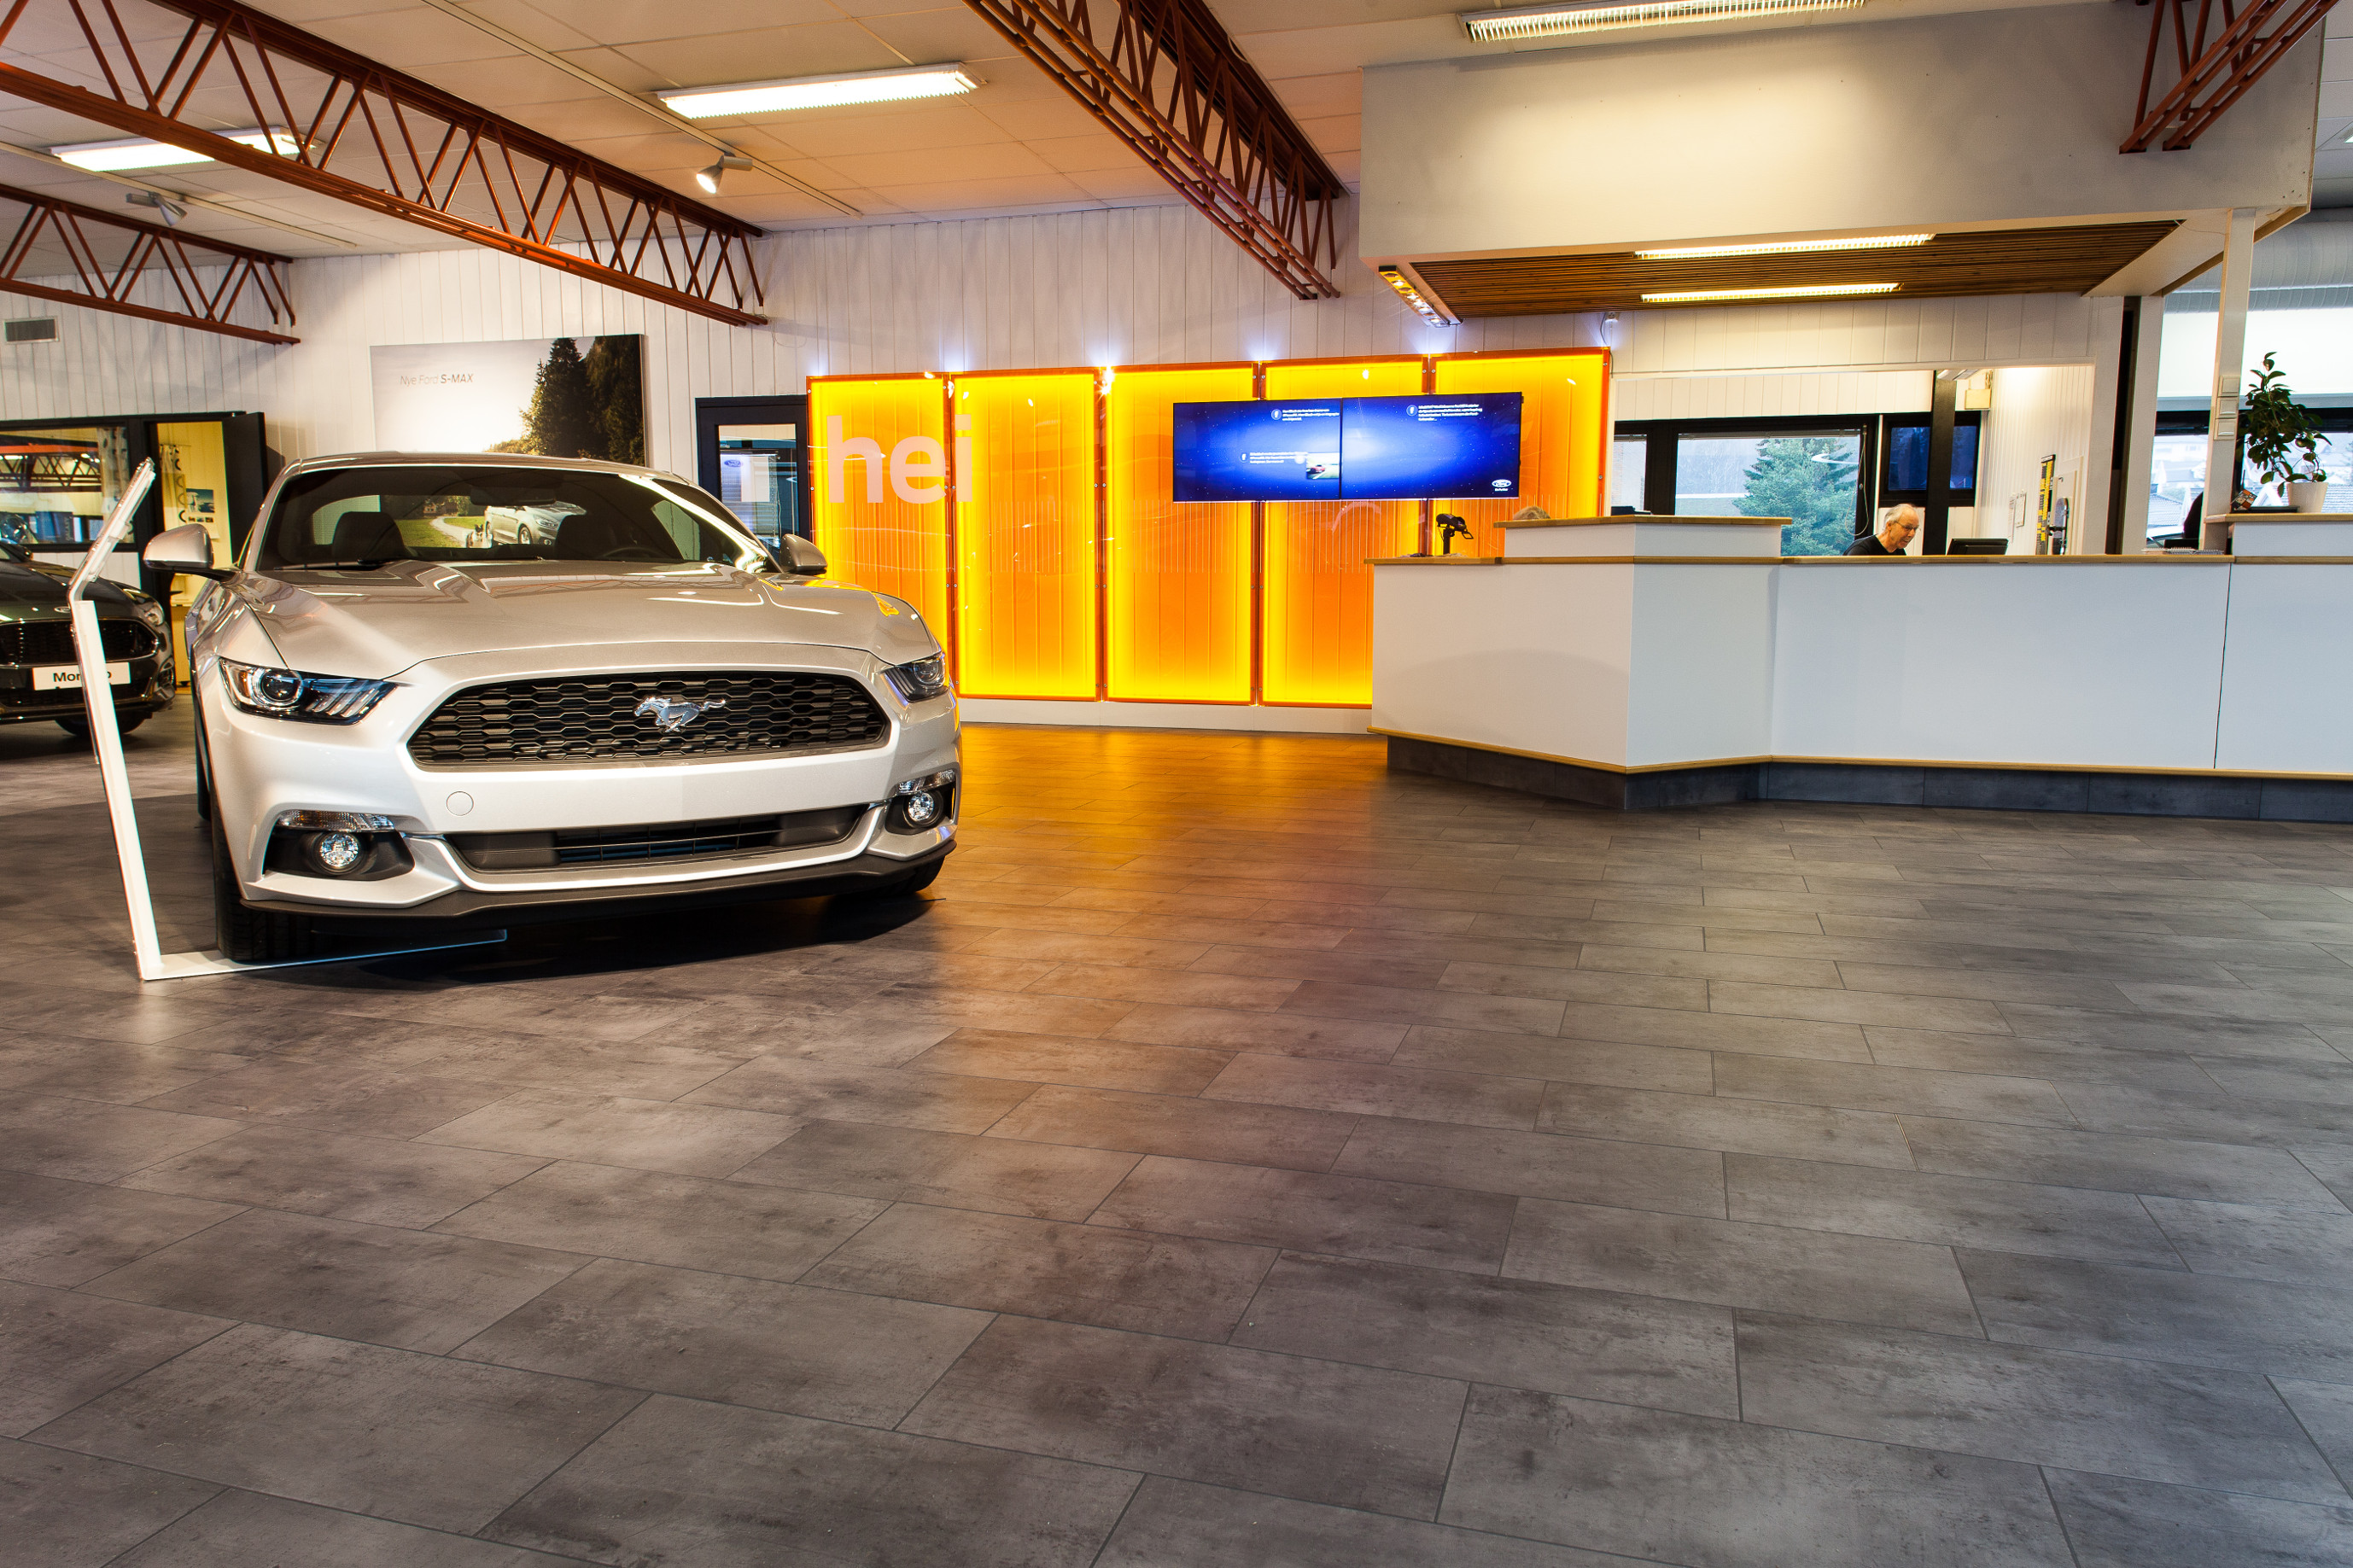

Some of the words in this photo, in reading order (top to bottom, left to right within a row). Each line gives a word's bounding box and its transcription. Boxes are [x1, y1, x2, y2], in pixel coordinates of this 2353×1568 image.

[400, 376, 417, 387] Nye
[418, 375, 439, 384] Ford
[440, 373, 474, 384] S-MAX
[826, 414, 972, 504] hei
